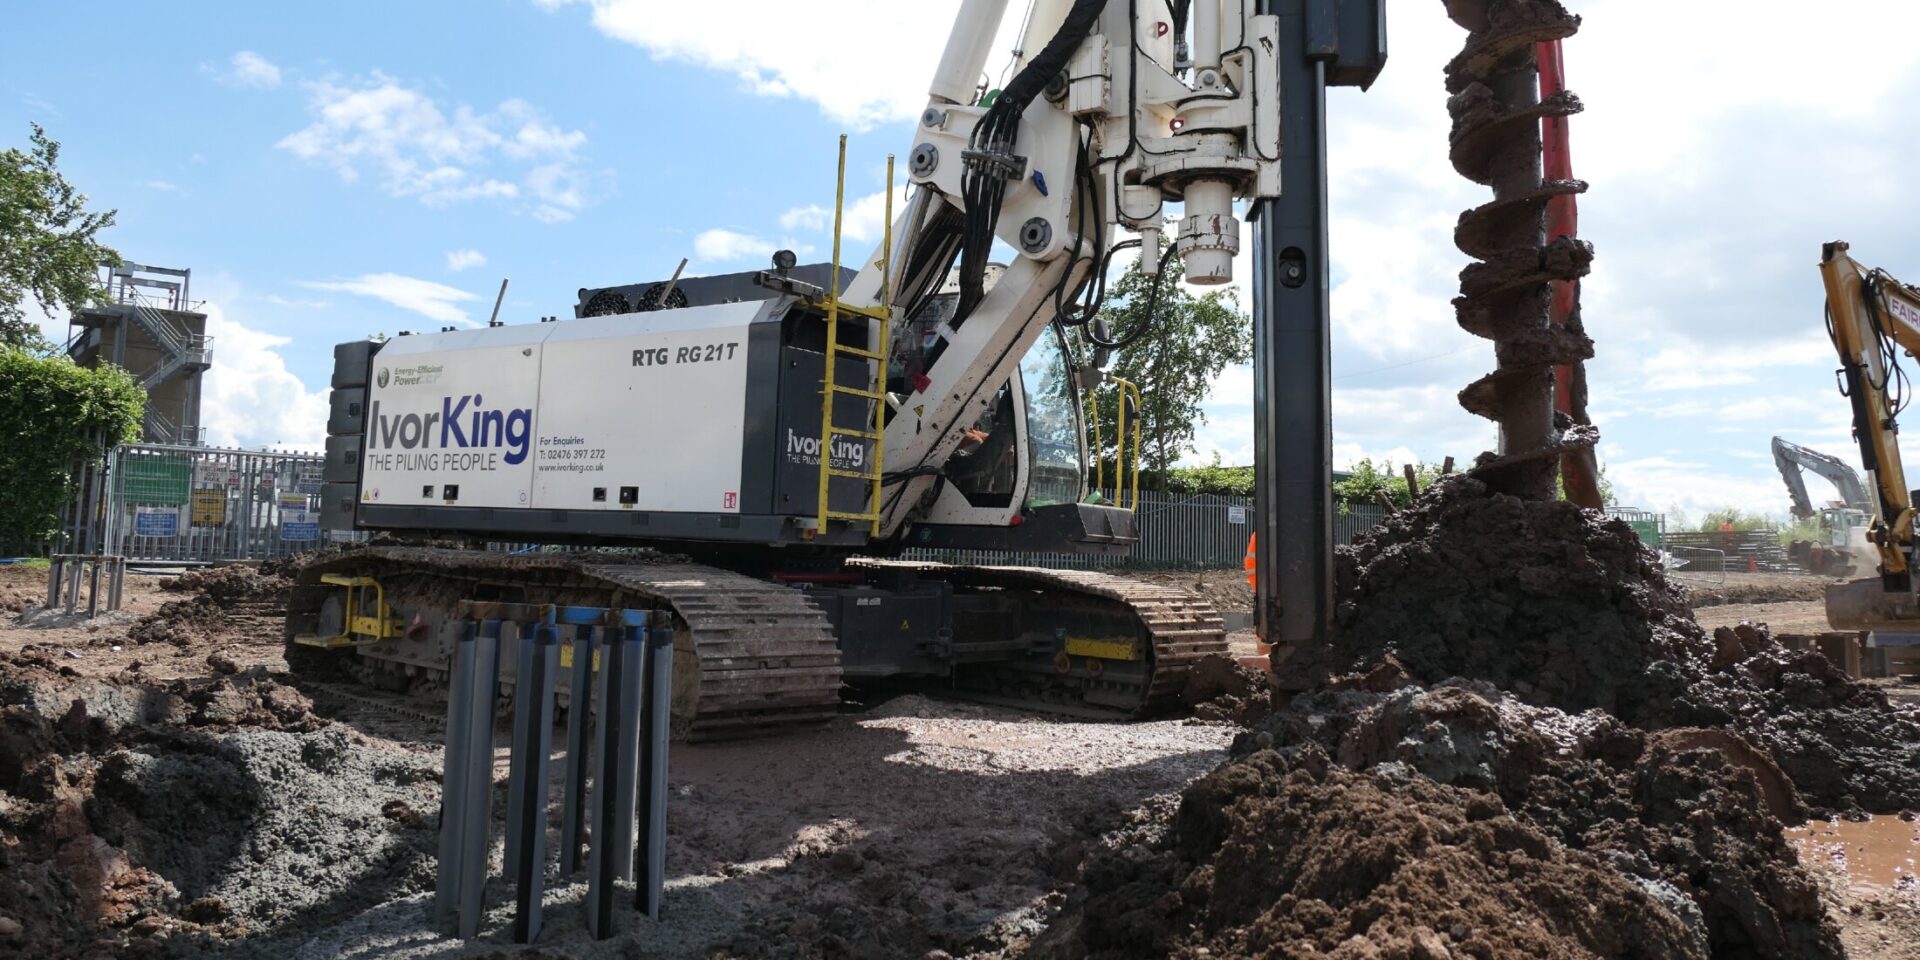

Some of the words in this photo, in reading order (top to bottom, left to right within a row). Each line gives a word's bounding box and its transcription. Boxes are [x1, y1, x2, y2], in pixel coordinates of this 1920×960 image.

[1892, 299, 1920, 328] FAIR
[632, 348, 668, 366] RTG
[393, 375, 421, 386] Power
[369, 394, 532, 465] IvorKing
[540, 436, 551, 446] For
[553, 435, 584, 447] Enquiries
[539, 450, 546, 460] T:
[547, 449, 571, 460] 02476
[573, 449, 588, 459] 397
[590, 449, 606, 459] 272
[787, 453, 801, 464] THE
[368, 454, 392, 471] THE
[395, 453, 438, 471] PILING
[442, 453, 497, 471] PEOPLE
[538, 462, 604, 473] www.ivorking.co.uk
